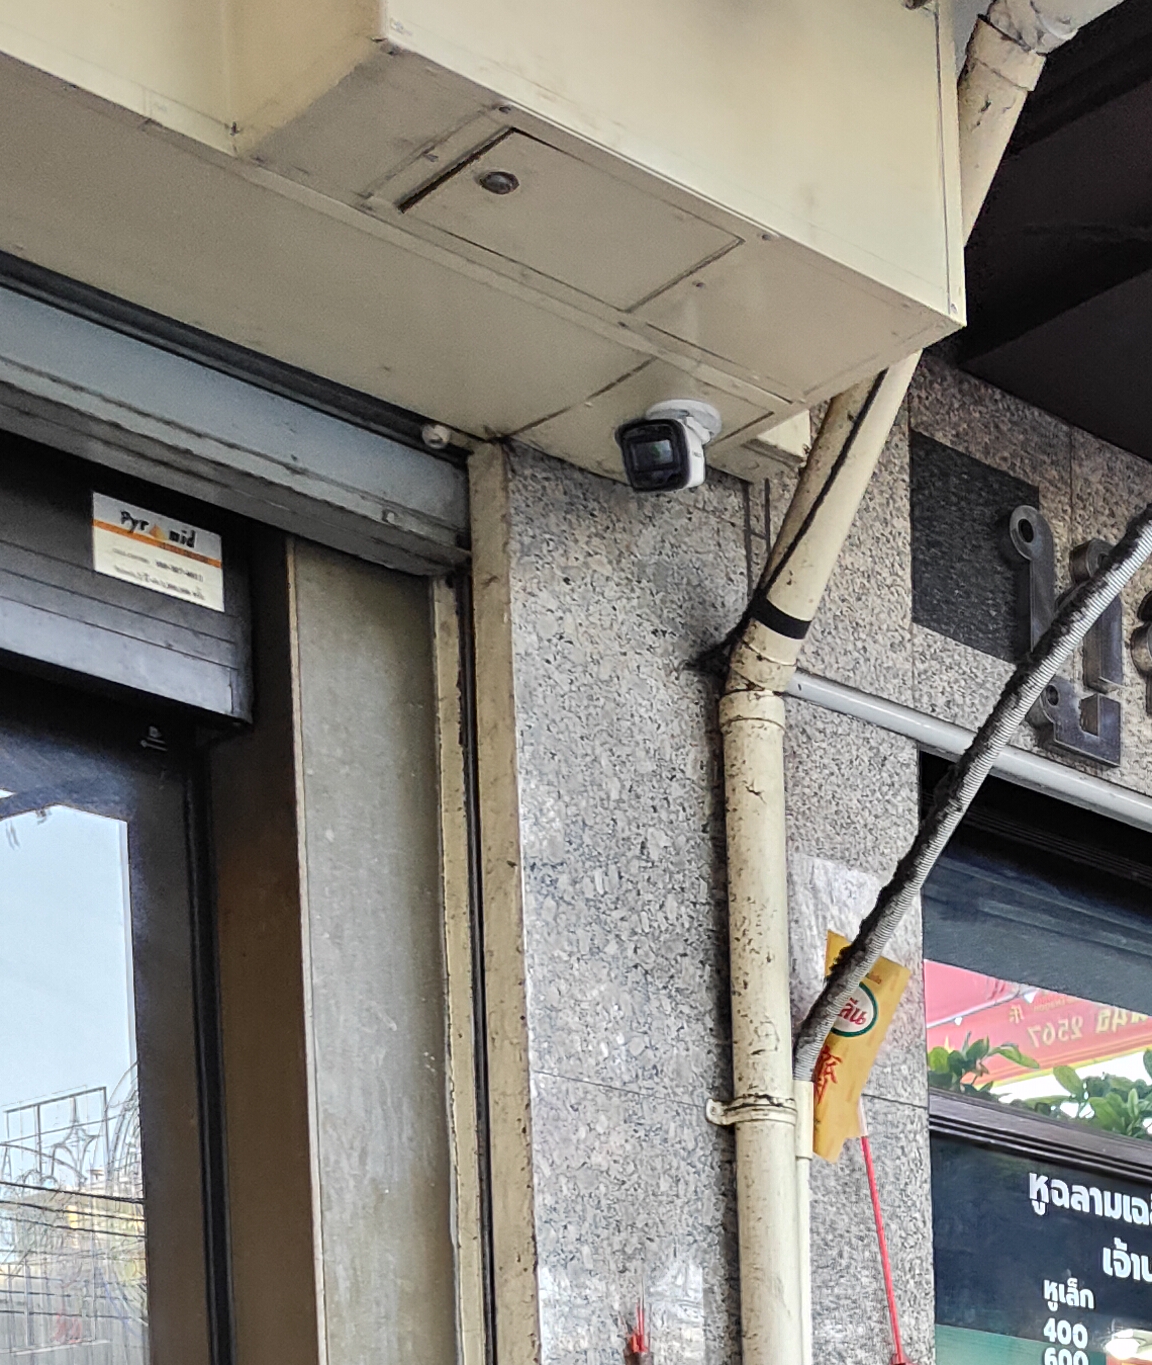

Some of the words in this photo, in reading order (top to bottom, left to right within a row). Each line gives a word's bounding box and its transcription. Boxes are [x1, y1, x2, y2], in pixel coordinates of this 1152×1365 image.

[1042, 1277, 1096, 1312] หูเล็ก
[1043, 1318, 1089, 1347] 400
